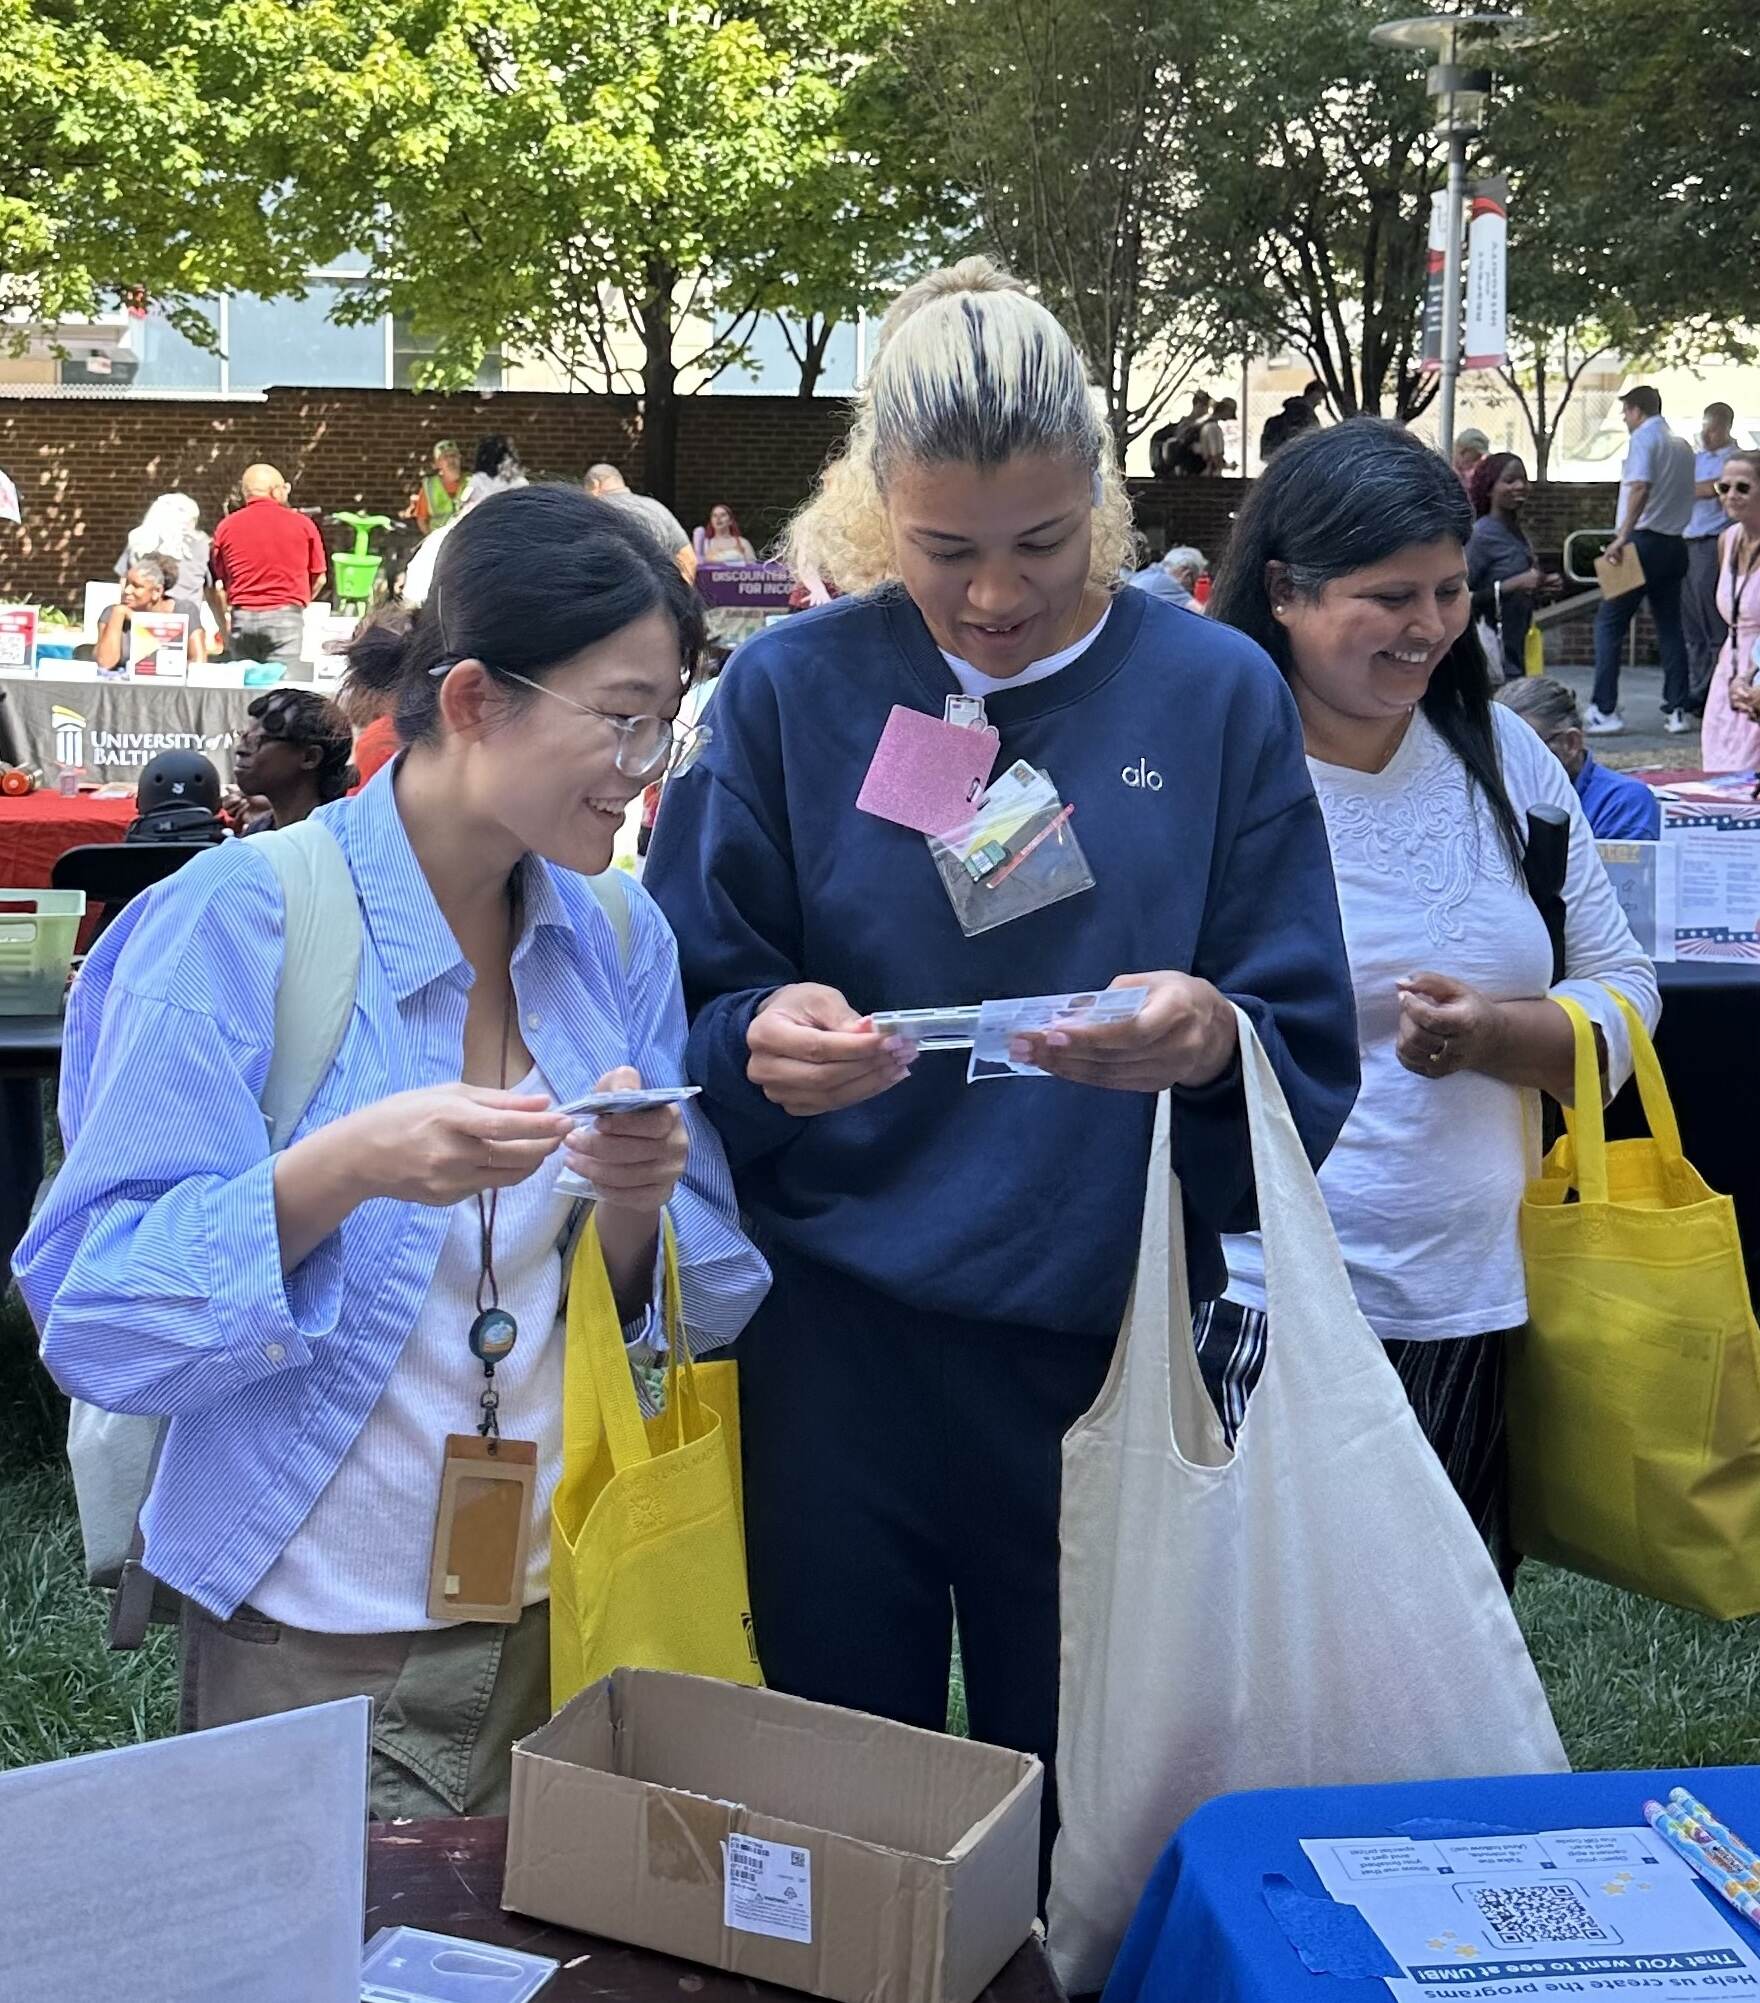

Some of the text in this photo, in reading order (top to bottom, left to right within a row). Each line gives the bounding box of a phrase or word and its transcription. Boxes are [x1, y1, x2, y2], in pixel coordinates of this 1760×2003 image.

[739, 583, 791, 595] FOR INCO
[206, 733, 222, 751] of
[93, 748, 158, 766] BALTI
[1122, 757, 1163, 791] alo
[1580, 1959, 1631, 1972] want
[1635, 1956, 1683, 1970] YOU
[1686, 1951, 1736, 1968] That
[1478, 1965, 1501, 1977] at
[1506, 1963, 1546, 1974] see
[1550, 1961, 1574, 1973] to
[1423, 1974, 1758, 2001] Help us create the programs
